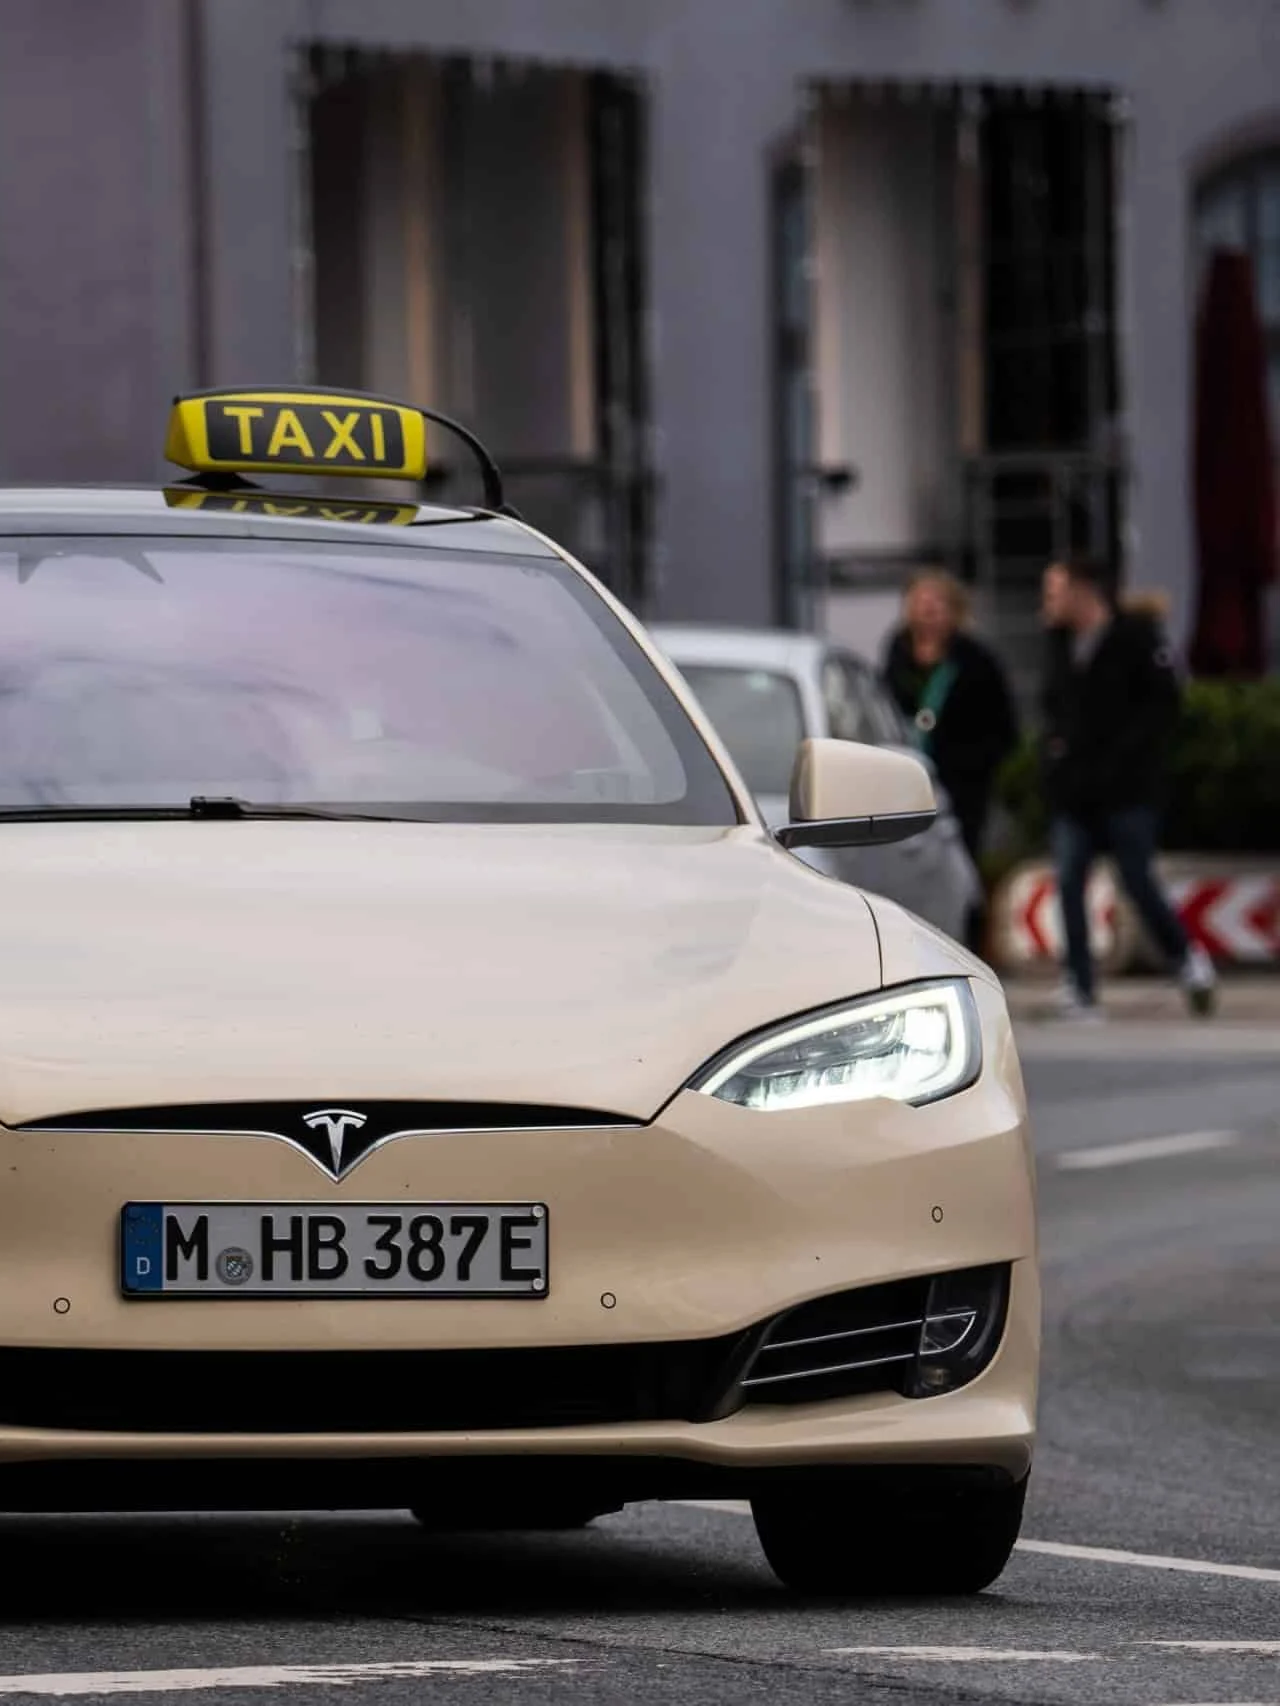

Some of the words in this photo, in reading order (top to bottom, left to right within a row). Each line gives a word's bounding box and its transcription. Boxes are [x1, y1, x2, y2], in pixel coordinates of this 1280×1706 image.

[223, 406, 385, 462] TAXI
[136, 1256, 150, 1275] D
[166, 1215, 209, 1281] M
[261, 1215, 349, 1281] HB
